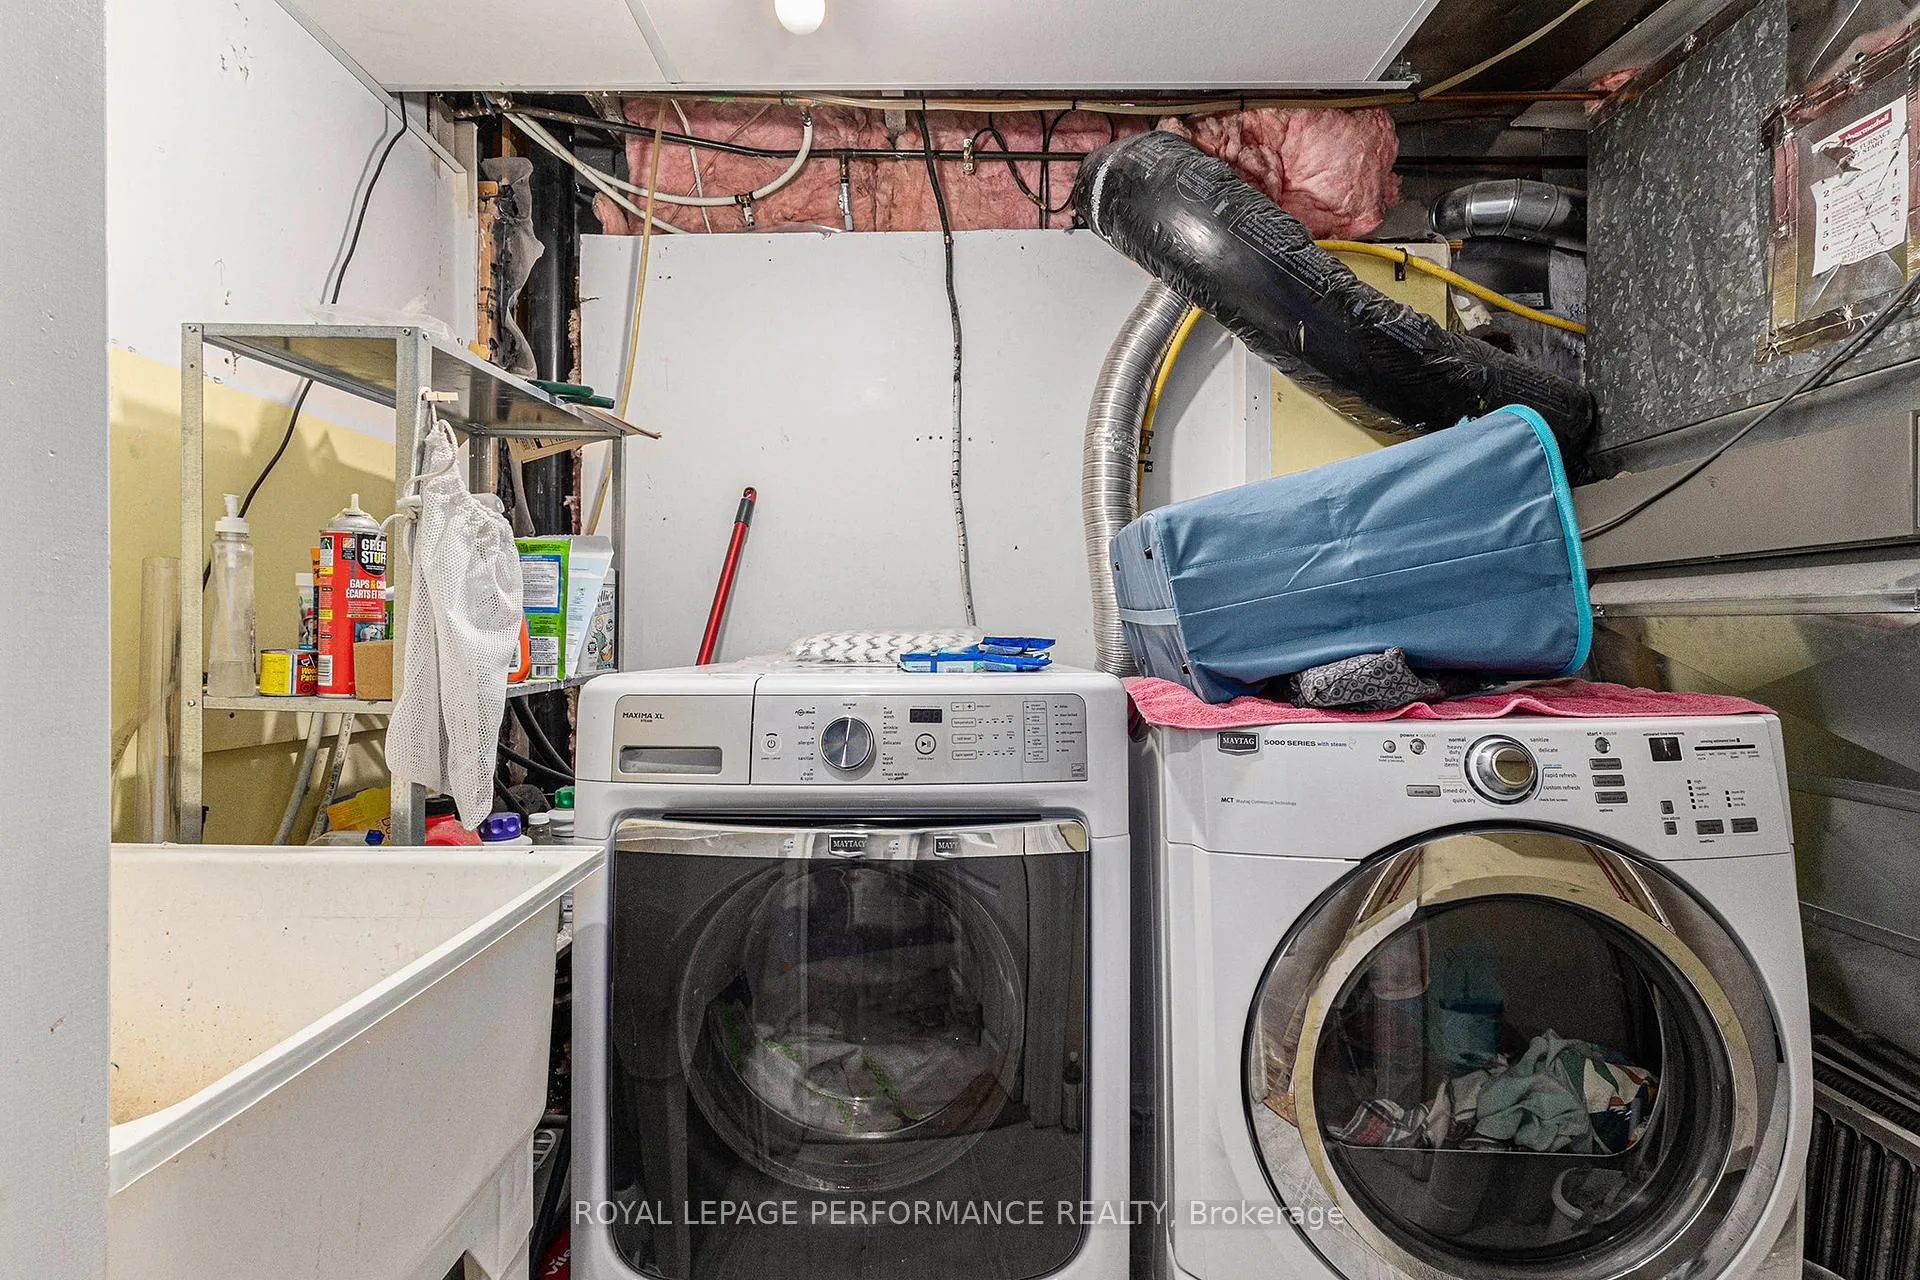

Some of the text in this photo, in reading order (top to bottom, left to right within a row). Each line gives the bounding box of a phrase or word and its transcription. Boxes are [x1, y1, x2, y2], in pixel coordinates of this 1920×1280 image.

[361, 538, 387, 552] GREA
[361, 551, 387, 564] STUF
[350, 578, 370, 589] GAPS
[370, 579, 376, 589] &
[345, 588, 371, 599] ÉCARTS
[301, 667, 317, 675] Woo
[1222, 737, 1255, 745] MAYTAG
[545, 1249, 572, 1276] vile
